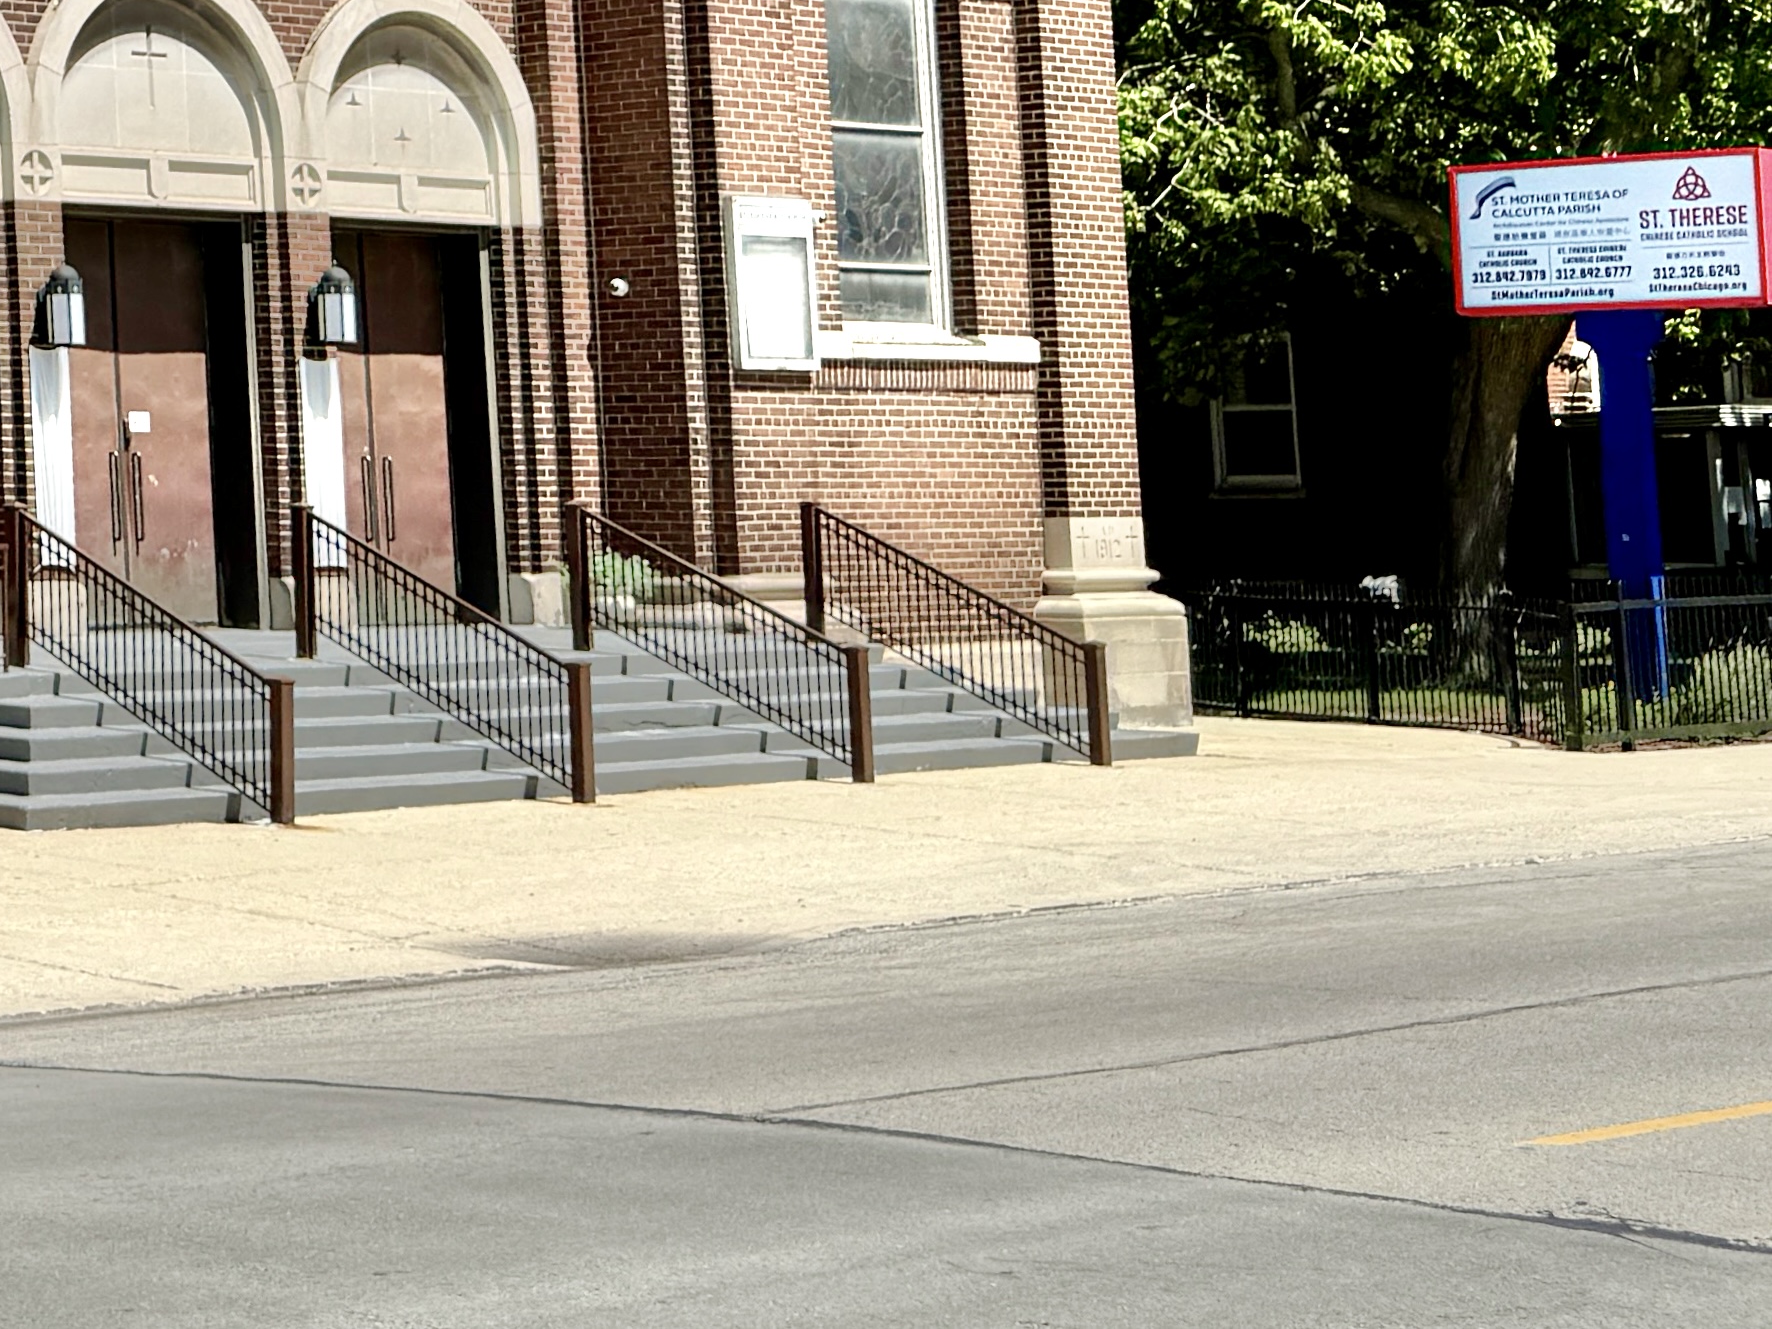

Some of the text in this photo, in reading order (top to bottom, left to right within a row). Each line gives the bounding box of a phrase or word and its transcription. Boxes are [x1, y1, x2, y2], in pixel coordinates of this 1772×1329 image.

[1510, 192, 1560, 205] MOTHER
[1564, 190, 1610, 202] TERESA
[1492, 204, 1601, 218] CALCUTTA PARISH
[1639, 210, 1663, 229] ST.
[1668, 205, 1748, 228] THERESE
